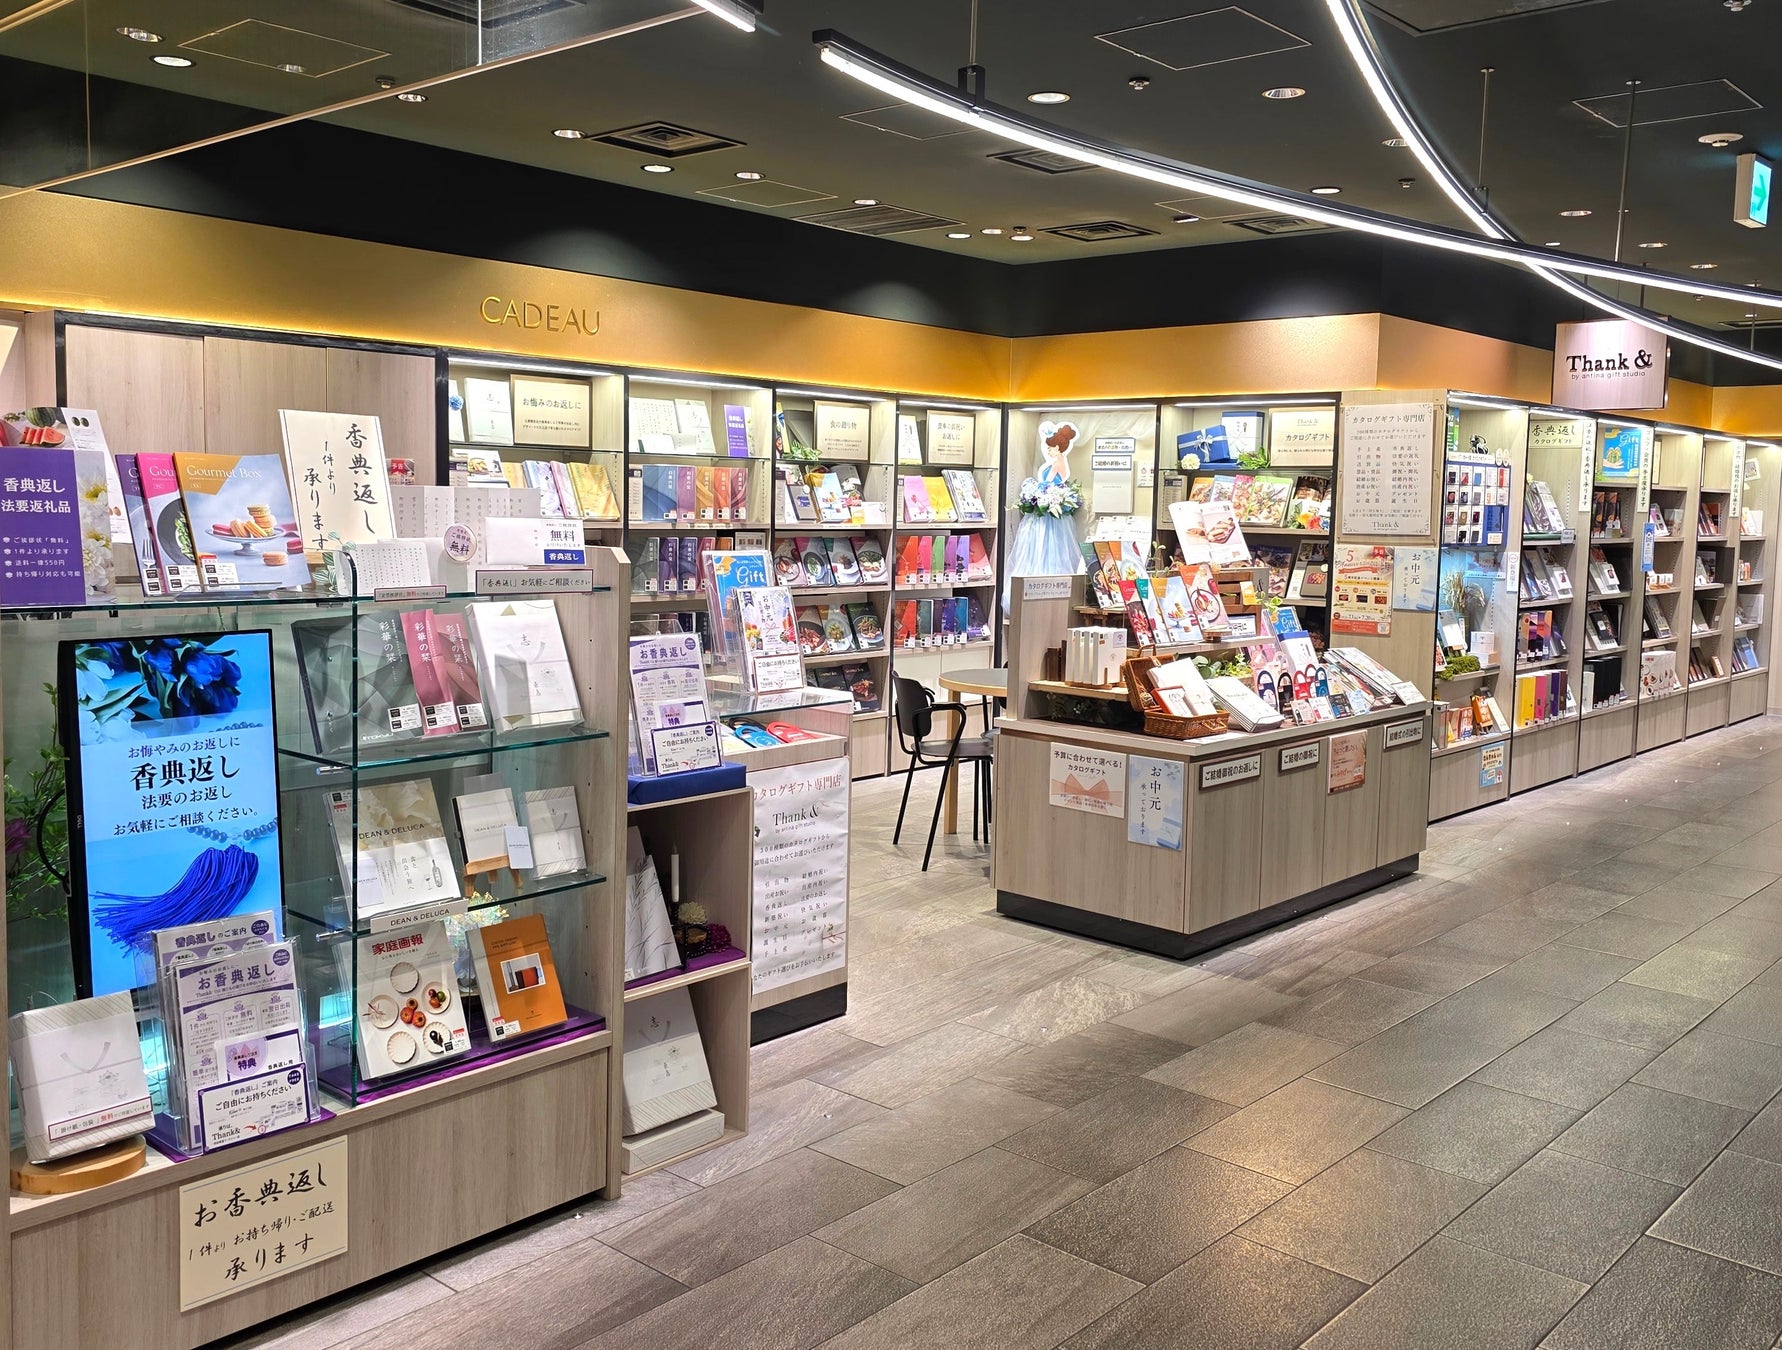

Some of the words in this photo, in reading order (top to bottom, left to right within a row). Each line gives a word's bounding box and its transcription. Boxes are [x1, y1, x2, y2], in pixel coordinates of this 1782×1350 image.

[480, 296, 601, 336] CADEAU
[1566, 353, 1630, 372] Thank
[1634, 349, 1653, 370] &
[1607, 371, 1621, 379] gift
[1622, 370, 1646, 378] studio
[523, 397, 582, 410] お悔みのお返しに
[1353, 414, 1425, 424] カタログギフト専門店
[1286, 432, 1330, 441] カタログギフト
[1532, 424, 1575, 436] 香典返し
[186, 465, 234, 478] Gourmet
[238, 468, 263, 479] Box
[345, 423, 378, 534] 香典返し
[4, 478, 65, 493] 香典返し
[1, 499, 71, 513] 法要返礼品
[303, 468, 328, 551] 承ります
[550, 529, 575, 542] 無料
[449, 540, 470, 556] 無料
[548, 552, 580, 561] 香典返し
[736, 566, 766, 586] Gift
[1411, 554, 1422, 585] お中元
[639, 646, 687, 660] お香典返し
[1389, 726, 1421, 742] 結婚式の引出物に
[128, 736, 241, 760] お悔やみのお返しに
[1283, 749, 1318, 764] ご結婚の御祝に
[130, 756, 241, 791] 香典返し
[1068, 764, 1106, 776] カタログギフト
[1204, 760, 1258, 781] ご結婚御祝のお返しに
[141, 785, 233, 811] 法要のお返し
[1150, 766, 1163, 811] お中元
[113, 807, 261, 837] お気軽にご相談ください。
[773, 808, 807, 826] Thank
[809, 804, 821, 818] &
[359, 830, 383, 840] DEAN
[384, 828, 390, 836] &
[391, 823, 425, 834] DELUCA
[390, 916, 412, 926] DEAN
[413, 914, 419, 922] &
[420, 908, 450, 920] DELUCA
[372, 933, 424, 956] 家庭画報
[198, 963, 275, 990] お香典返し
[237, 1057, 257, 1071] 特典
[215, 1085, 292, 1111] ご自由にお持ちください
[211, 1127, 241, 1141] Thank&
[194, 1162, 327, 1228] お香典返し
[233, 1201, 335, 1245] お持ち帰り・ご配送
[224, 1233, 314, 1281] 承ります
